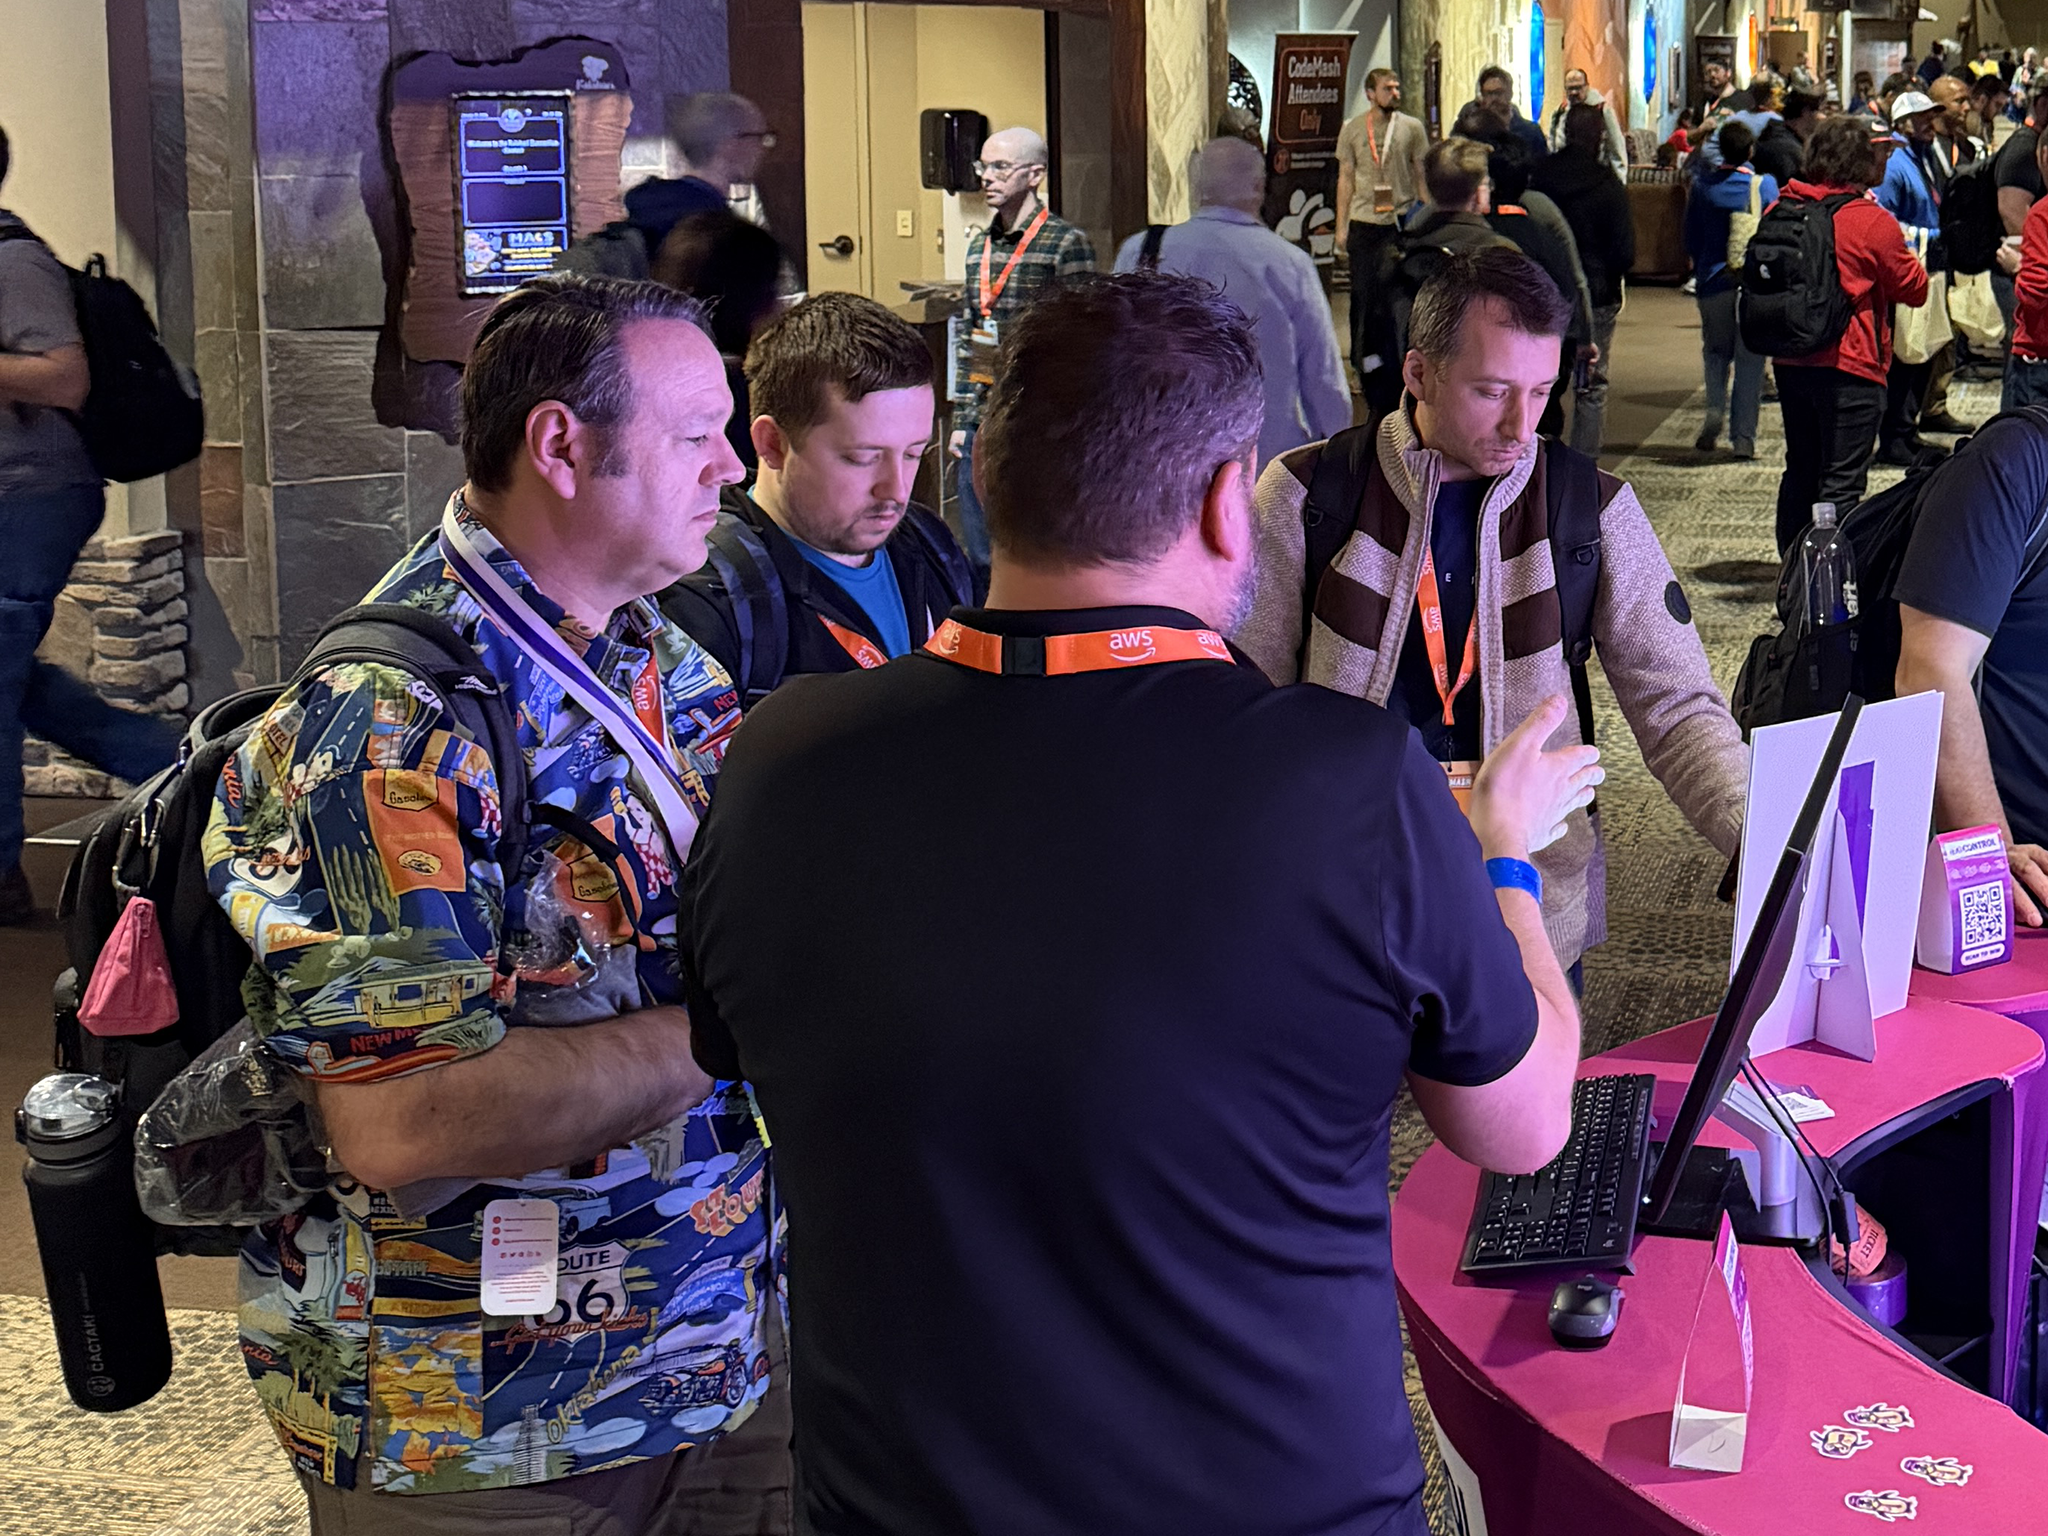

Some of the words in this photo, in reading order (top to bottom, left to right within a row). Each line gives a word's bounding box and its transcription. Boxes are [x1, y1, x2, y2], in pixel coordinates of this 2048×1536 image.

[1288, 55, 1341, 78] CodeMash
[1287, 82, 1338, 105] Attendees
[1109, 630, 1153, 650] aws
[1197, 632, 1222, 647] aw
[633, 676, 651, 711] aws
[269, 723, 289, 747] OTEL
[350, 1032, 392, 1053] NEW
[690, 1183, 727, 1235] ST
[1860, 1229, 1879, 1259] TICKET
[557, 1250, 610, 1272] OUTE
[82, 1314, 105, 1372] CACTAKI
